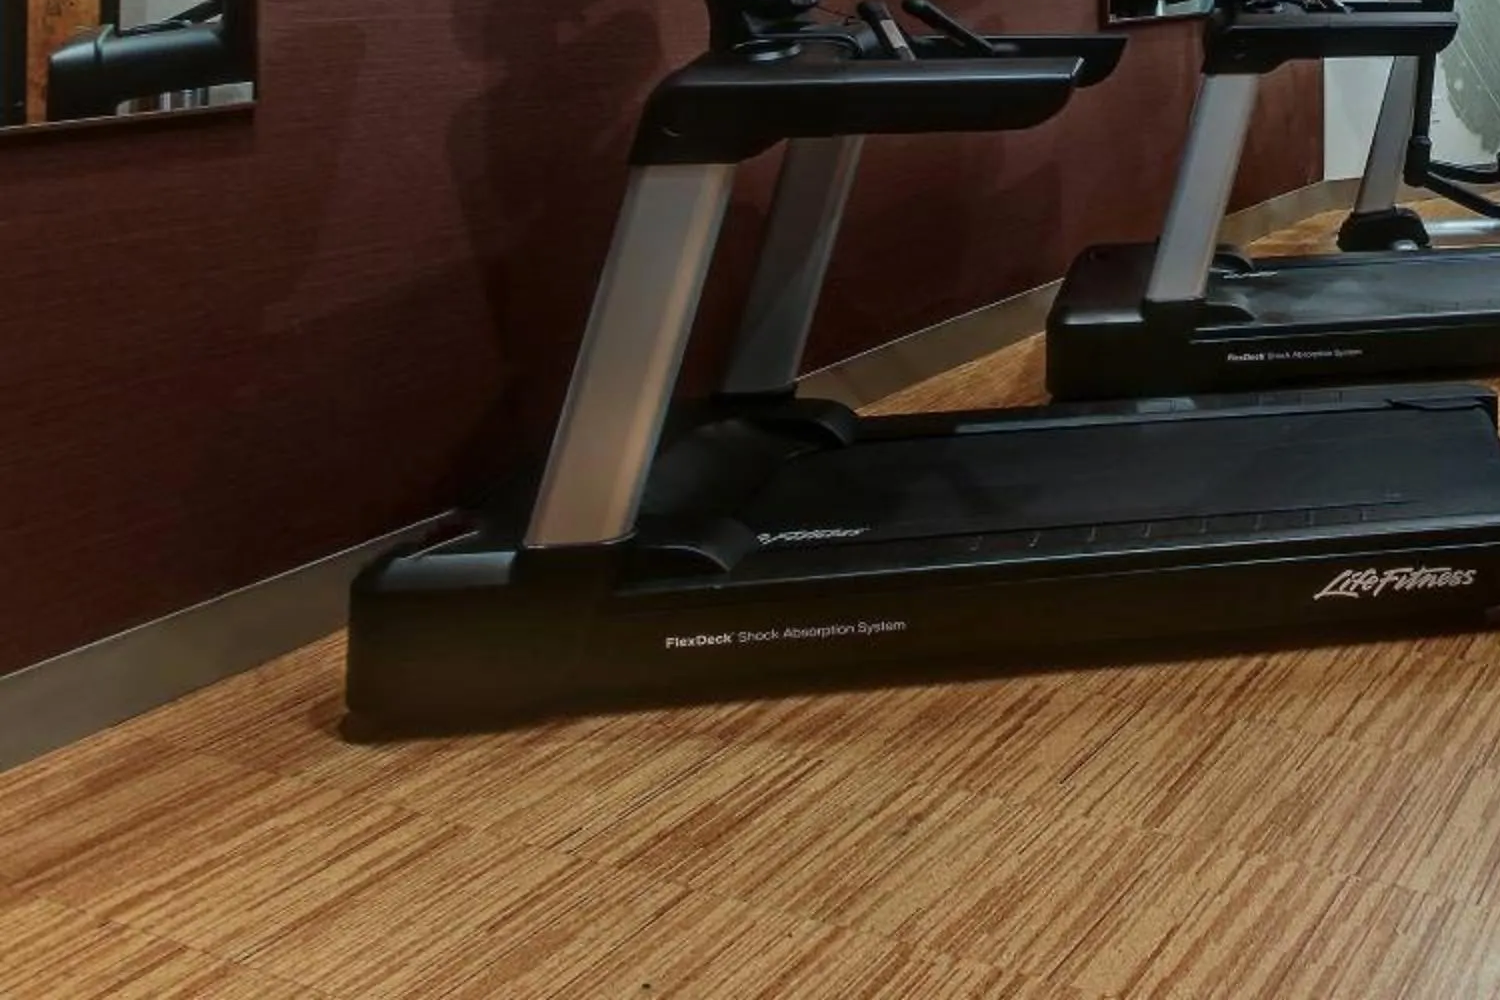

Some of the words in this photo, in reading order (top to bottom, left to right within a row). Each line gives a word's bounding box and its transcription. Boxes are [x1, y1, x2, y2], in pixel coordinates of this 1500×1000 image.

[665, 633, 732, 649] FlexDeck
[737, 630, 780, 643] Shock
[783, 622, 855, 640] Absorption
[857, 619, 907, 636] System
